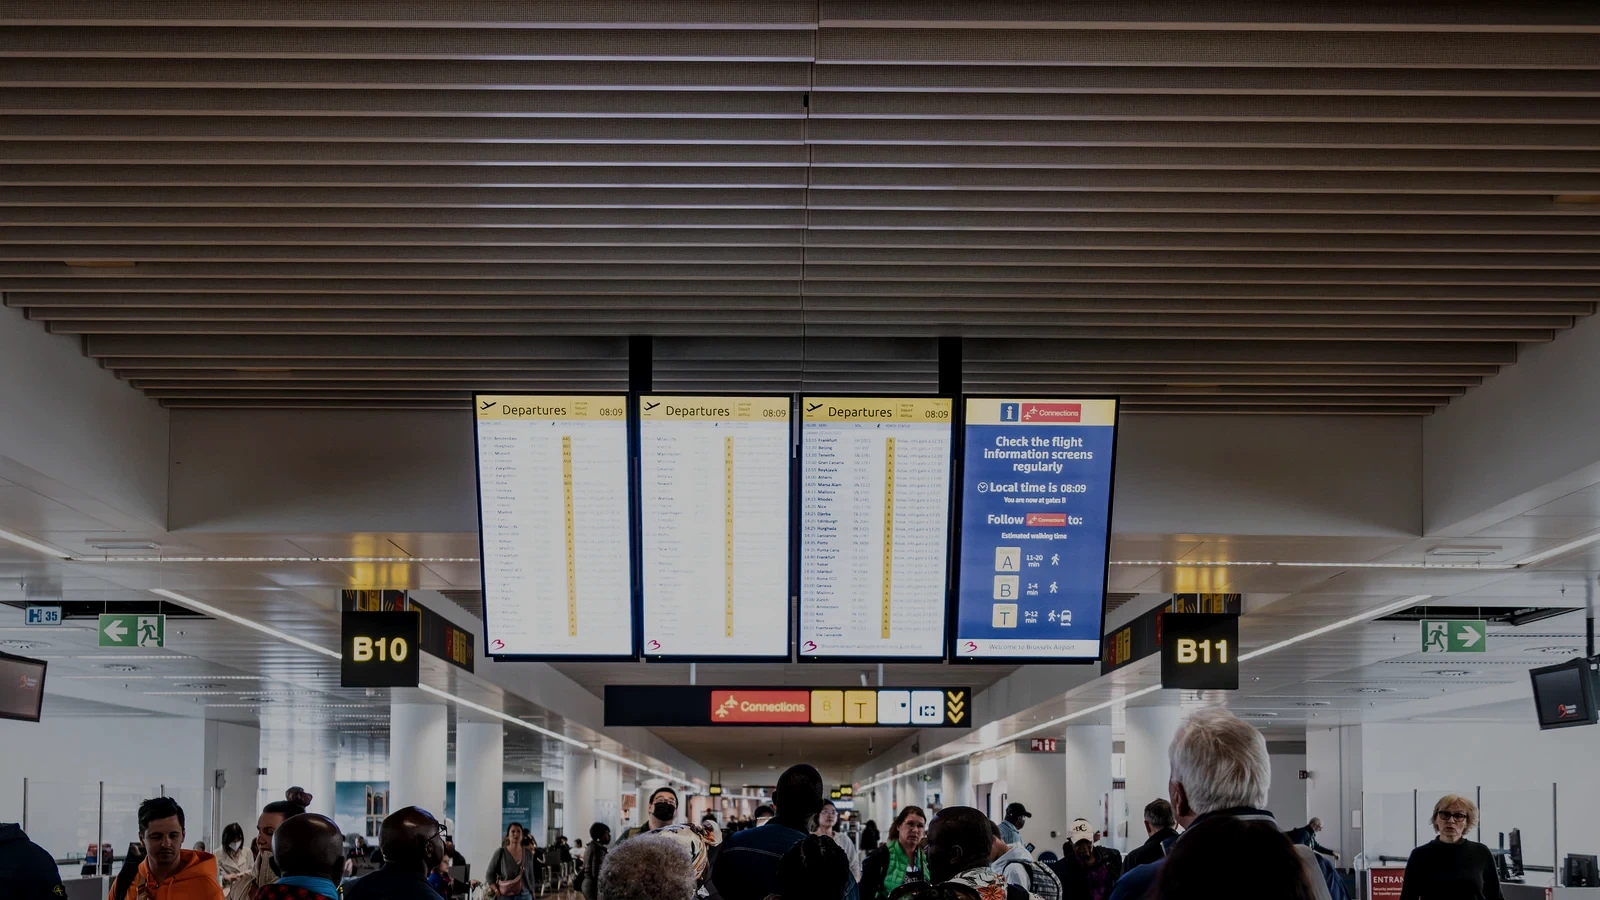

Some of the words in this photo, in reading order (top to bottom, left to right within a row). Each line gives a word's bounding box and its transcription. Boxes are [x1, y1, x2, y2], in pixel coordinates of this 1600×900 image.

[502, 404, 566, 417] Departures
[666, 406, 730, 418] Departures
[763, 409, 786, 417] 08:09
[828, 406, 892, 419] Departures
[996, 436, 1028, 447] Check
[1031, 436, 1050, 447] the
[1052, 436, 1083, 449] flight
[984, 449, 1049, 460] information
[1051, 451, 1093, 460] screens
[1013, 462, 1063, 474] regularly
[990, 482, 1018, 492] Local
[1021, 482, 1046, 492] time
[1048, 482, 1057, 492] is
[1060, 484, 1086, 493] 08:09
[988, 514, 1024, 524] Follow
[1068, 515, 1082, 524] to:
[1002, 556, 1012, 569] A
[1001, 584, 1011, 597] B
[45, 611, 57, 621] 35
[1000, 612, 1010, 625] T
[353, 636, 407, 662] B10
[1177, 639, 1228, 663] B11
[741, 701, 806, 712] Connections
[823, 701, 831, 710] B
[854, 702, 867, 719] T
